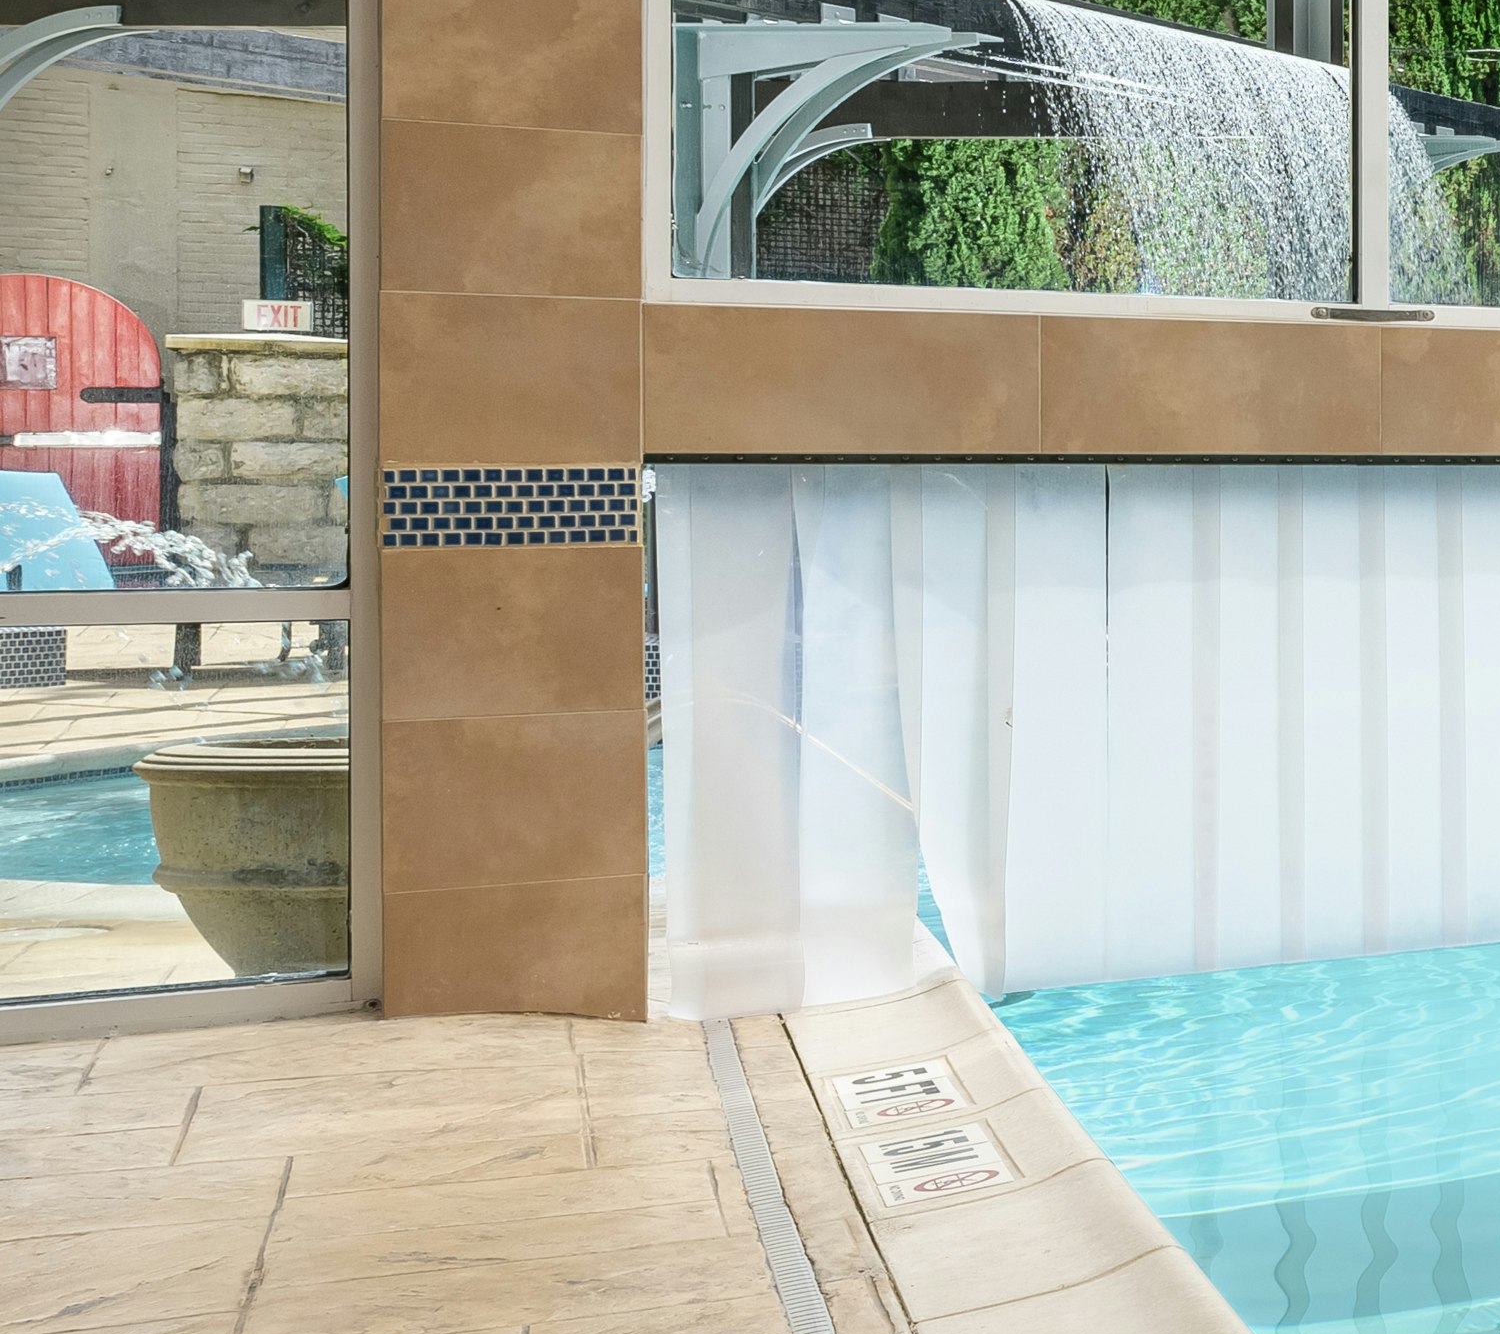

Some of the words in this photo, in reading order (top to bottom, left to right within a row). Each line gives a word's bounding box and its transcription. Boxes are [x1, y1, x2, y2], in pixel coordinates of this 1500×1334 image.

[256, 304, 302, 328] EXIT
[851, 1067, 928, 1085] 5
[889, 1147, 979, 1173] M
